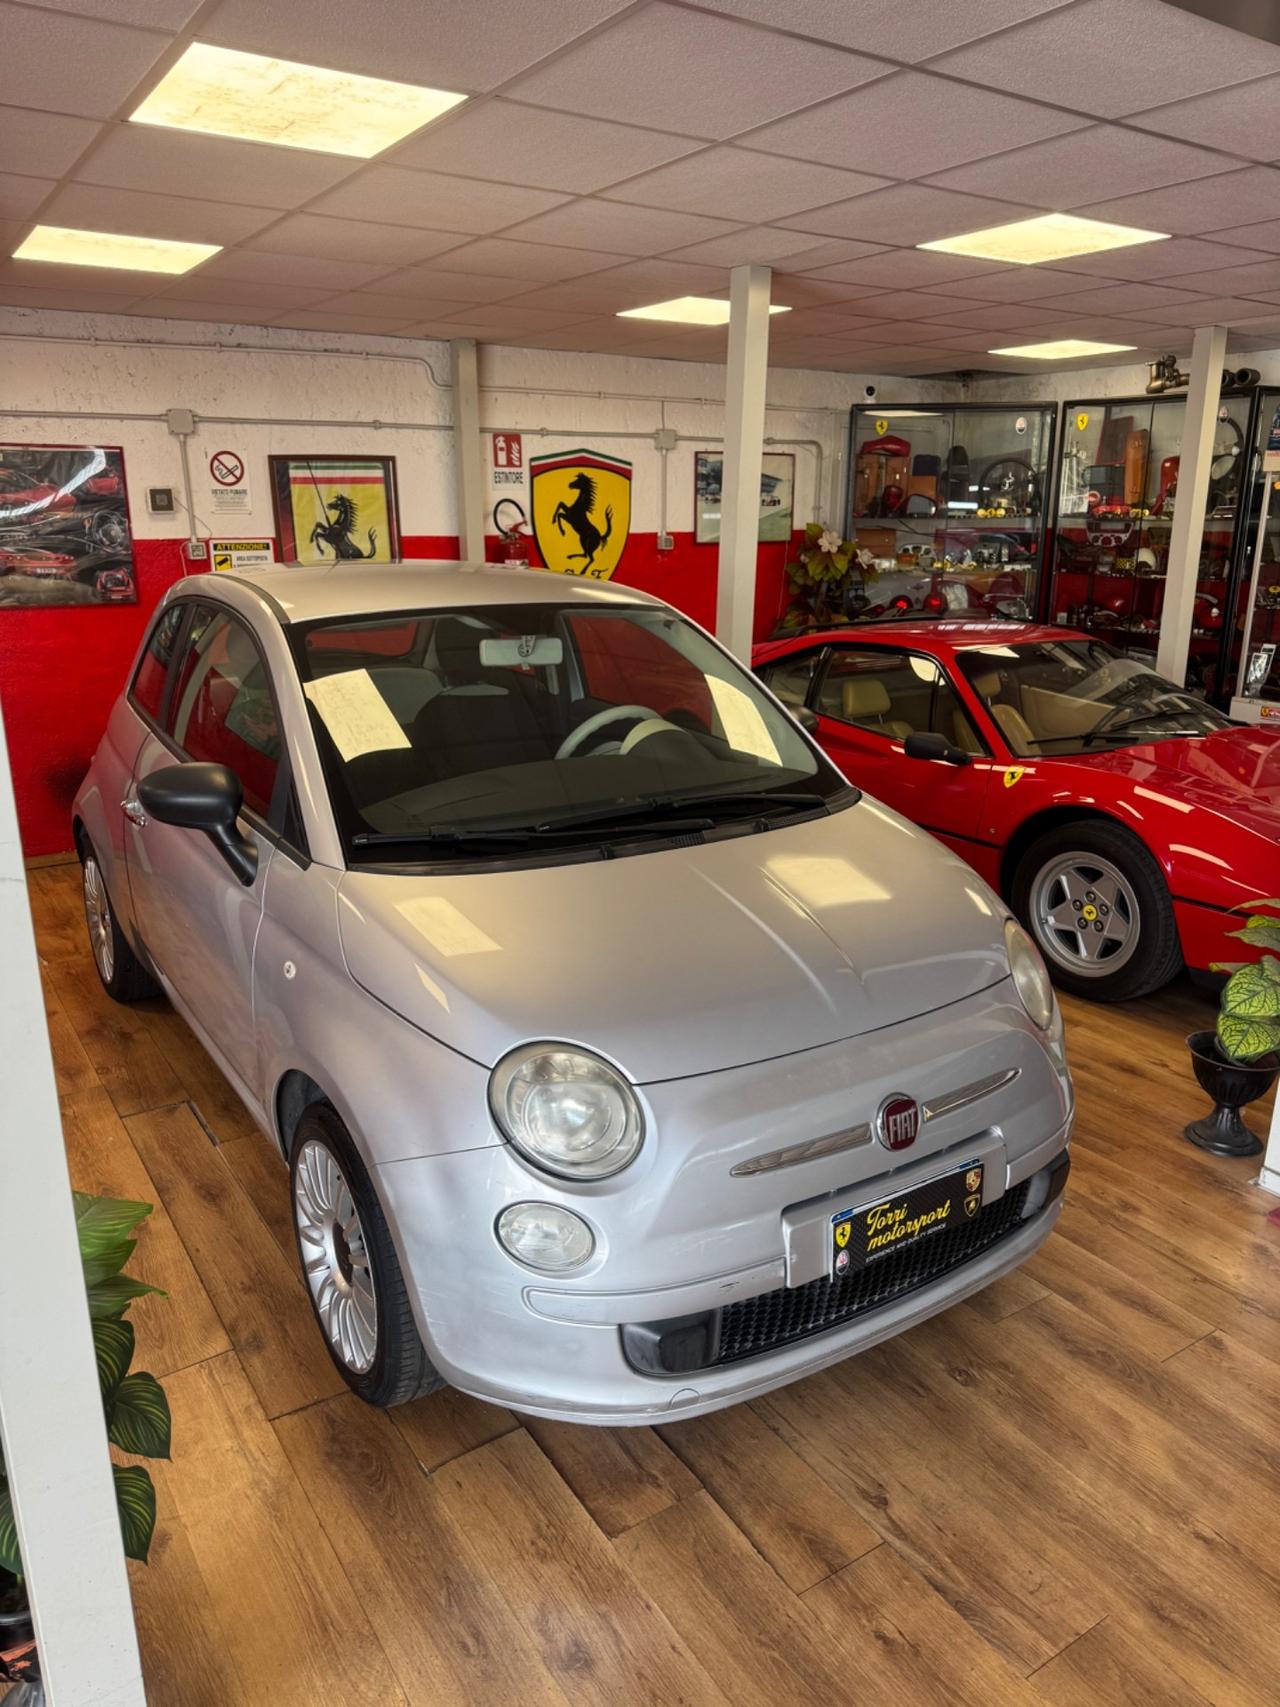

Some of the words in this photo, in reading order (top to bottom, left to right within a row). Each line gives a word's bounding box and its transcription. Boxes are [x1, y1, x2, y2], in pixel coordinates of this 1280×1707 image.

[216, 543, 267, 551] ATTENZIONE!
[888, 1108, 916, 1144] FIAT
[866, 1203, 907, 1236] Torri
[867, 1200, 950, 1252] motorsport
